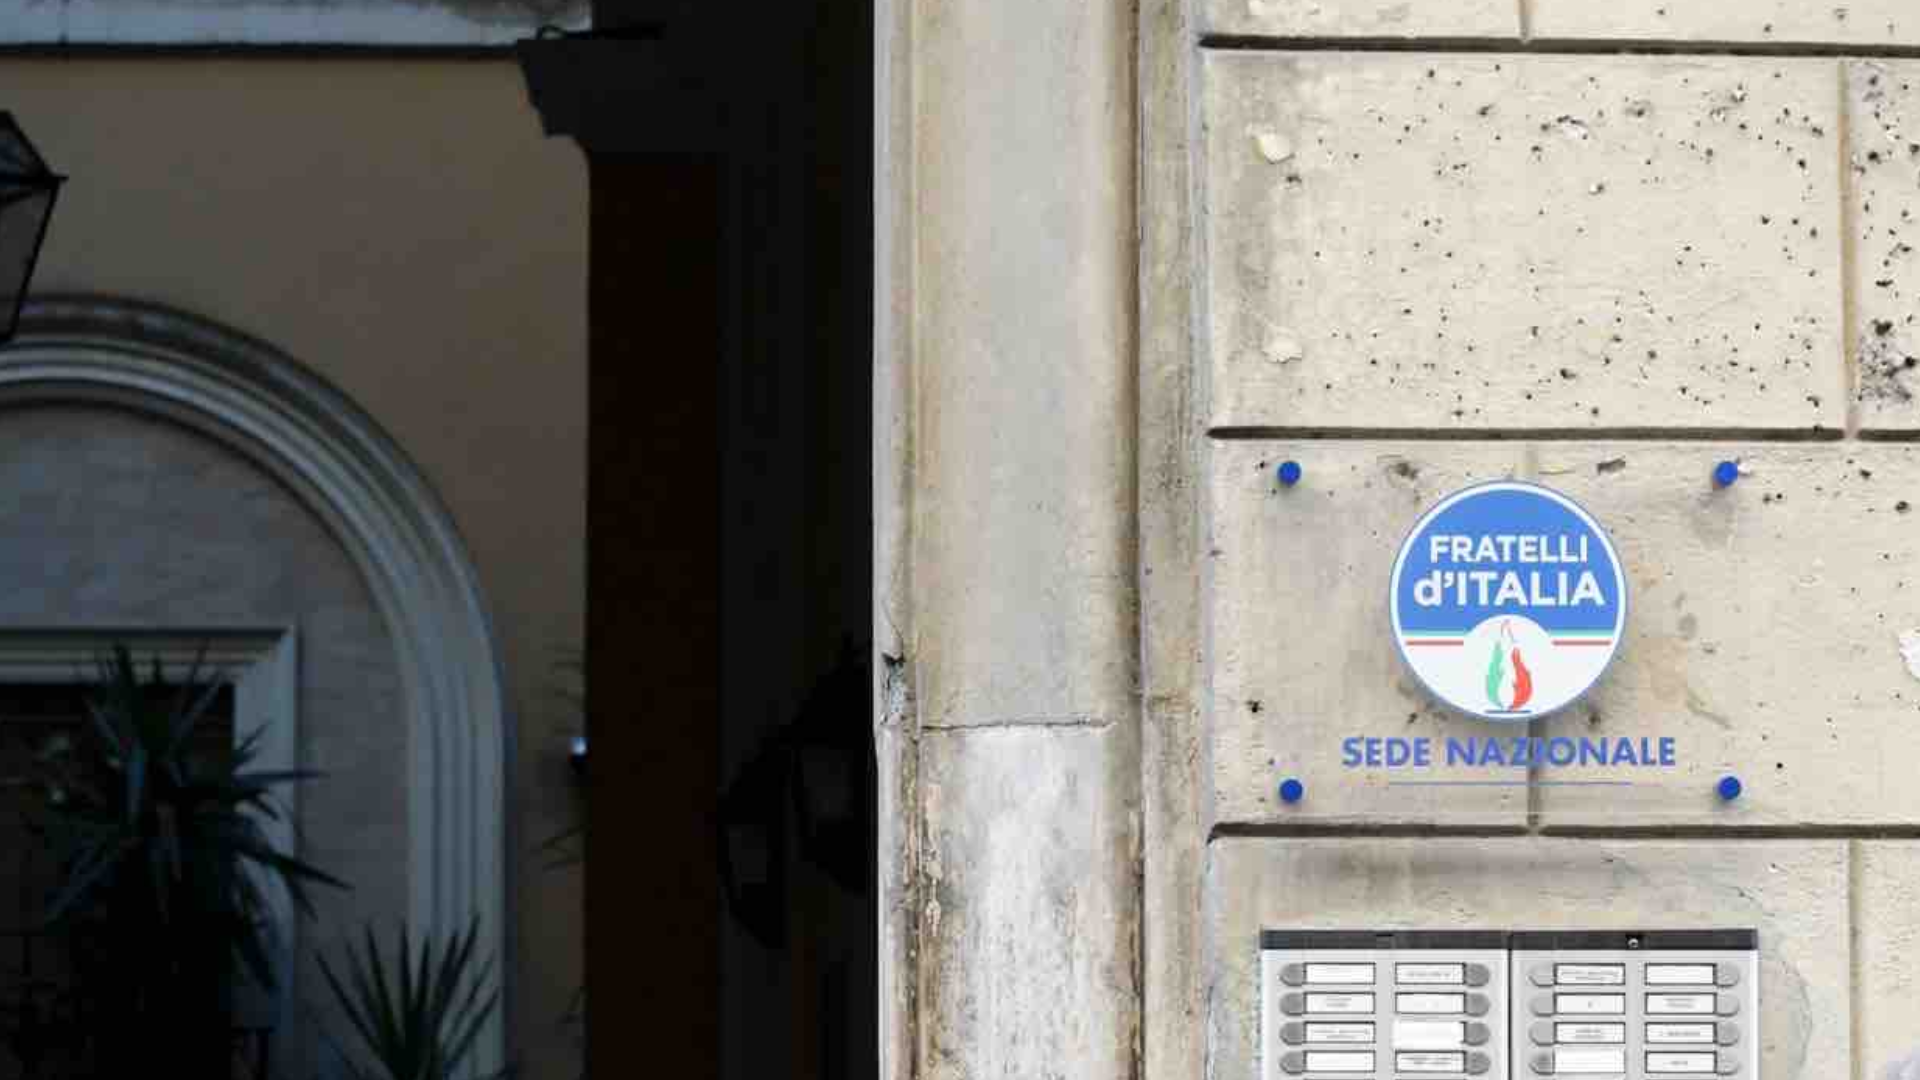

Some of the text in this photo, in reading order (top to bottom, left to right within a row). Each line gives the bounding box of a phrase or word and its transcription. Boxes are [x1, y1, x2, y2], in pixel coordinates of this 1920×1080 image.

[1429, 535, 1589, 563] FRATELLI
[1413, 571, 1605, 607] d'ITALIA
[1341, 737, 1676, 767] SEDE NAZIONALE
